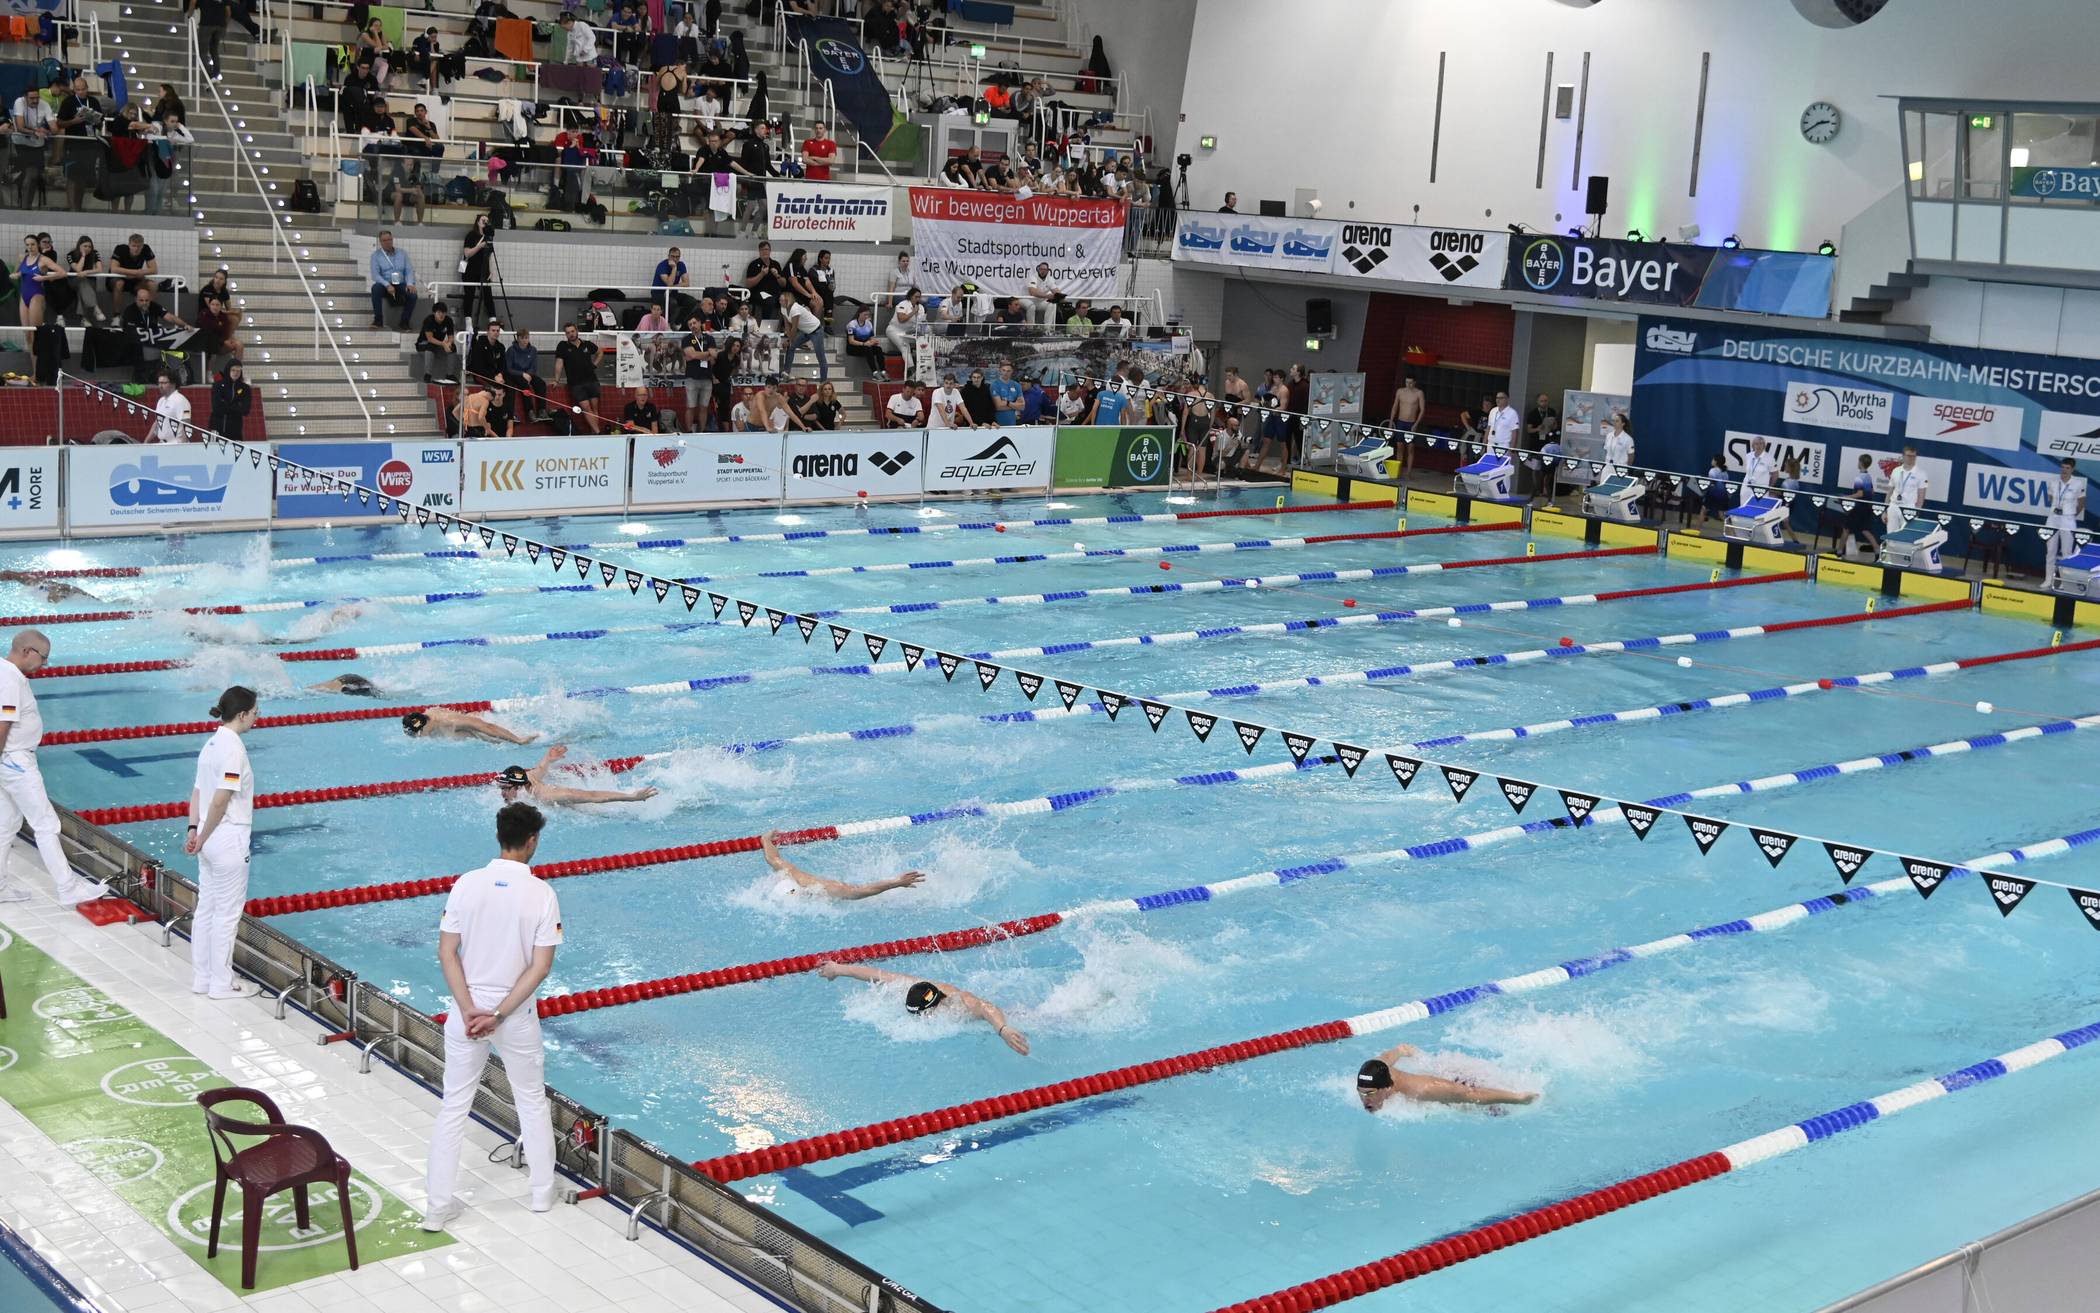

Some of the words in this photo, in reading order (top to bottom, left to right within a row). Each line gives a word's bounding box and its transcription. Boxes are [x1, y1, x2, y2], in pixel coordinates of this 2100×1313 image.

[775, 193, 887, 216] hartmann
[912, 194, 942, 214] Wir
[949, 197, 1025, 222] bewegen
[1032, 203, 1115, 227] Wuppertal
[773, 216, 856, 230] Bürotechnik
[1179, 221, 1226, 249] dsv
[1230, 224, 1279, 254] dsv
[1342, 224, 1392, 247] arena
[1430, 231, 1484, 254] arena
[957, 238, 1065, 258] Stadtsportbund
[1075, 244, 1085, 258] &
[1283, 228, 1334, 258] dsv
[1526, 259, 1560, 269] BAYER
[1537, 244, 1547, 285] BAYER
[1572, 246, 1679, 296] Bayer
[1646, 324, 1697, 352] dsv
[1722, 338, 1832, 369] DEUTSCHE
[1842, 391, 1886, 408] Myrtha
[1840, 405, 1874, 420] Pools
[1933, 403, 1994, 423] speedo
[536, 457, 609, 472] KONTAKT
[1130, 453, 1159, 461] BAYER
[1141, 438, 1149, 477] BAYER
[1812, 449, 1822, 478] MORE
[793, 453, 858, 478] arena
[940, 460, 1037, 482] aquafeel
[109, 455, 234, 507] dsv
[338, 470, 357, 479] Duo
[536, 475, 608, 489] STIFTUNG
[30, 467, 42, 509] MORE
[284, 484, 297, 492] für
[422, 494, 453, 506] AWG
[110, 508, 145, 516] Deutscher
[147, 505, 210, 515] Schwimm-Verband
[1529, 544, 1534, 553] 2
[1146, 704, 1164, 717] arena
[1191, 714, 1211, 727] arena
[1239, 726, 1259, 738] arena
[1288, 736, 1309, 749] arena
[1340, 748, 1361, 760] arena
[1392, 759, 1415, 772] arena
[1448, 771, 1470, 785] arena
[1504, 783, 1529, 797] arena
[1566, 796, 1591, 809] arena
[1627, 808, 1652, 822] arena
[1692, 820, 1718, 835] arena
[1759, 834, 1787, 848] arena
[1833, 848, 1862, 864] arena
[1910, 863, 1942, 878] arena
[1992, 878, 2024, 894] arena
[882, 1277, 918, 1301] OMEGA
